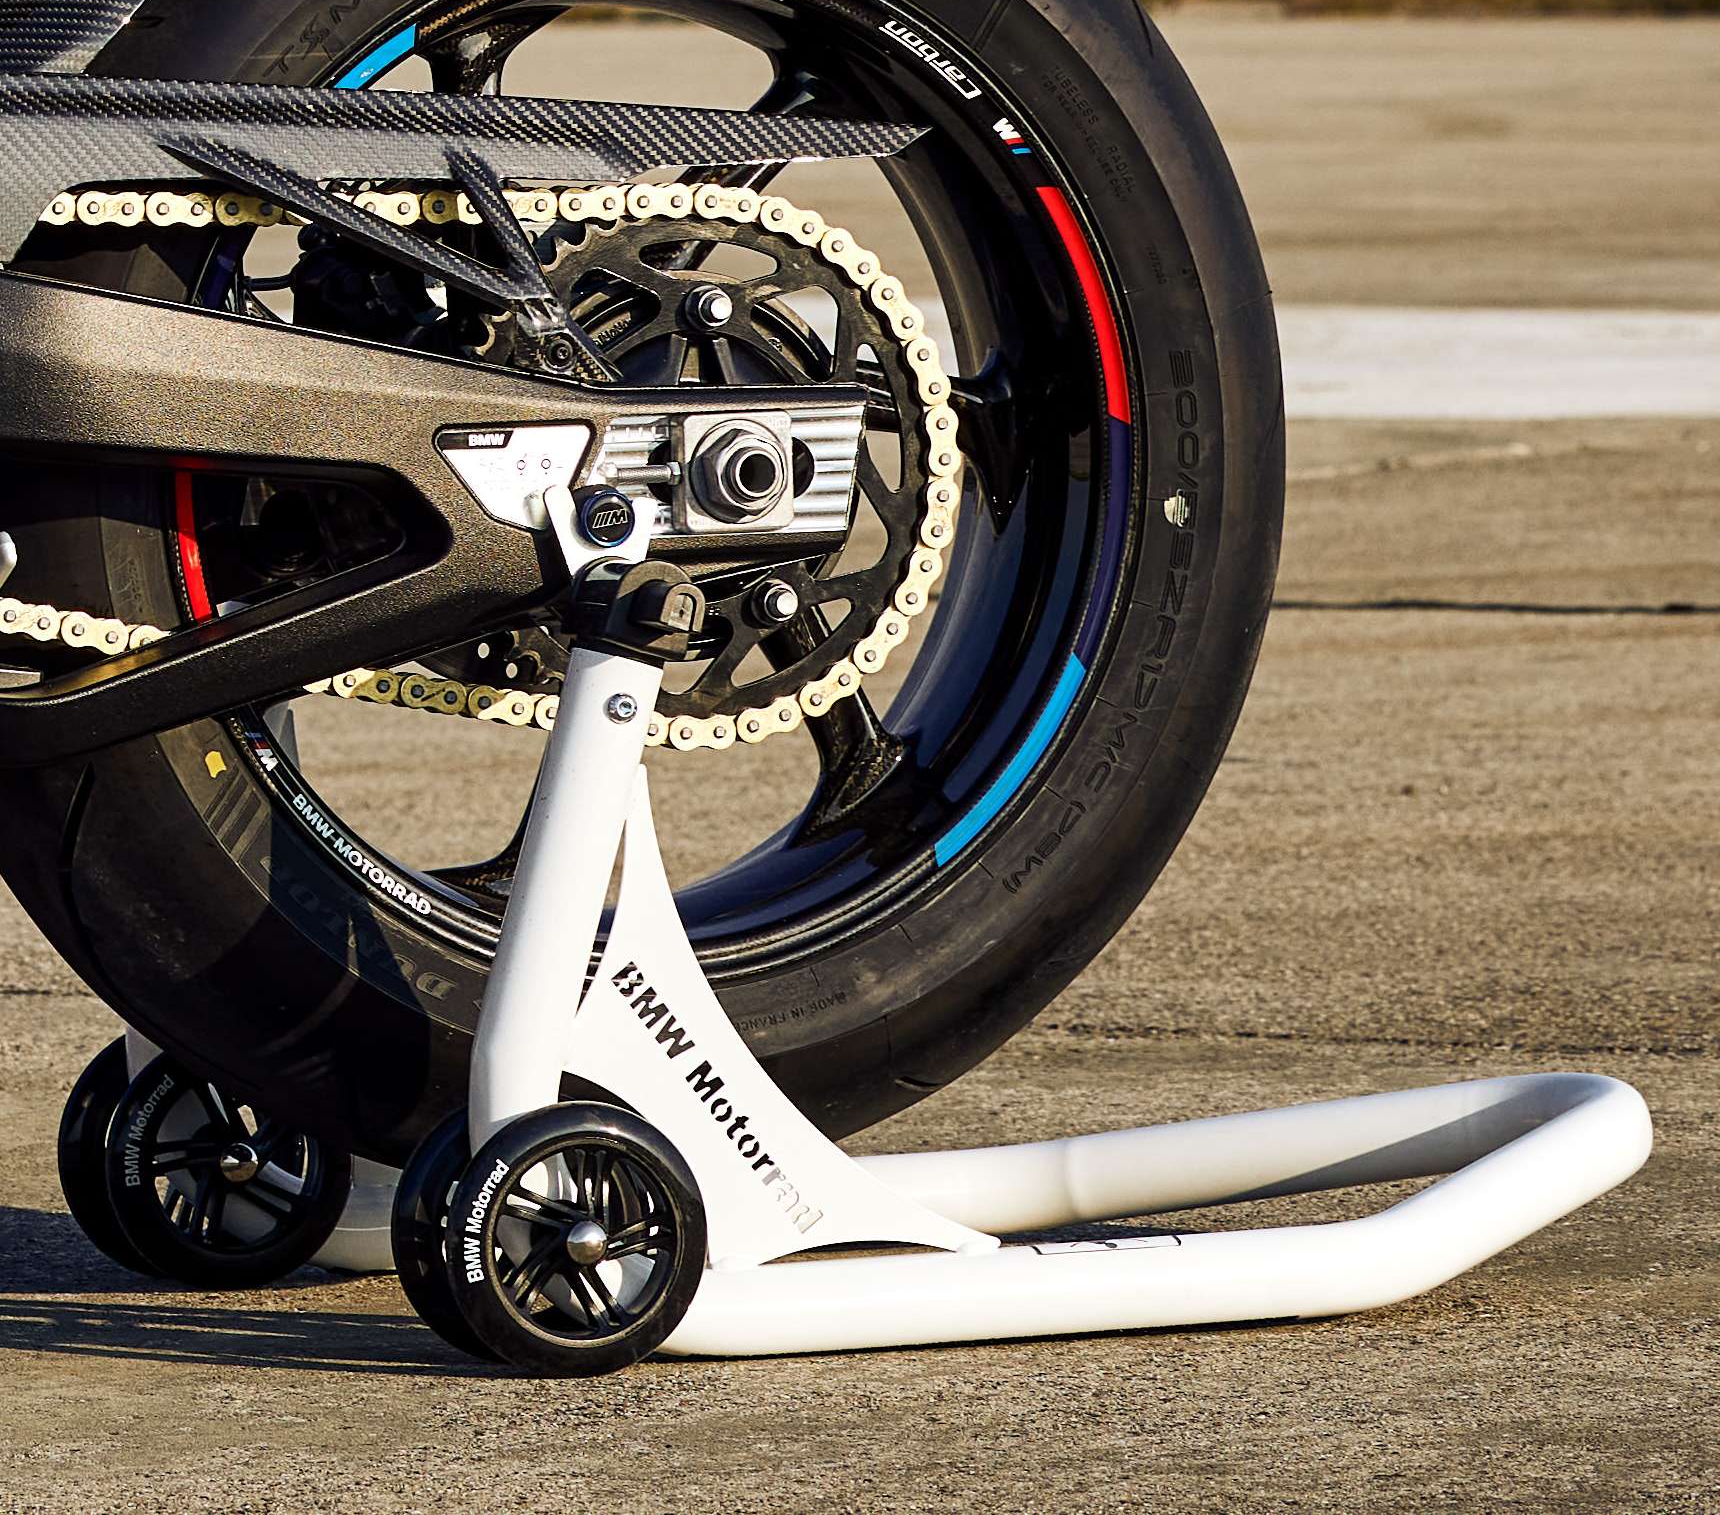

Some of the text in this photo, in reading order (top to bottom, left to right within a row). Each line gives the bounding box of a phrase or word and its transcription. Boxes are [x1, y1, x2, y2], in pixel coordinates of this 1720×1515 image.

[878, 20, 982, 99] Carbon
[468, 433, 506, 448] BMW
[292, 792, 433, 916] BMW MOTORRAD
[123, 1073, 176, 1188] BMW Motorrad
[611, 961, 824, 1235] BMW Motorrad
[462, 1157, 511, 1285] BMW Motorrad
